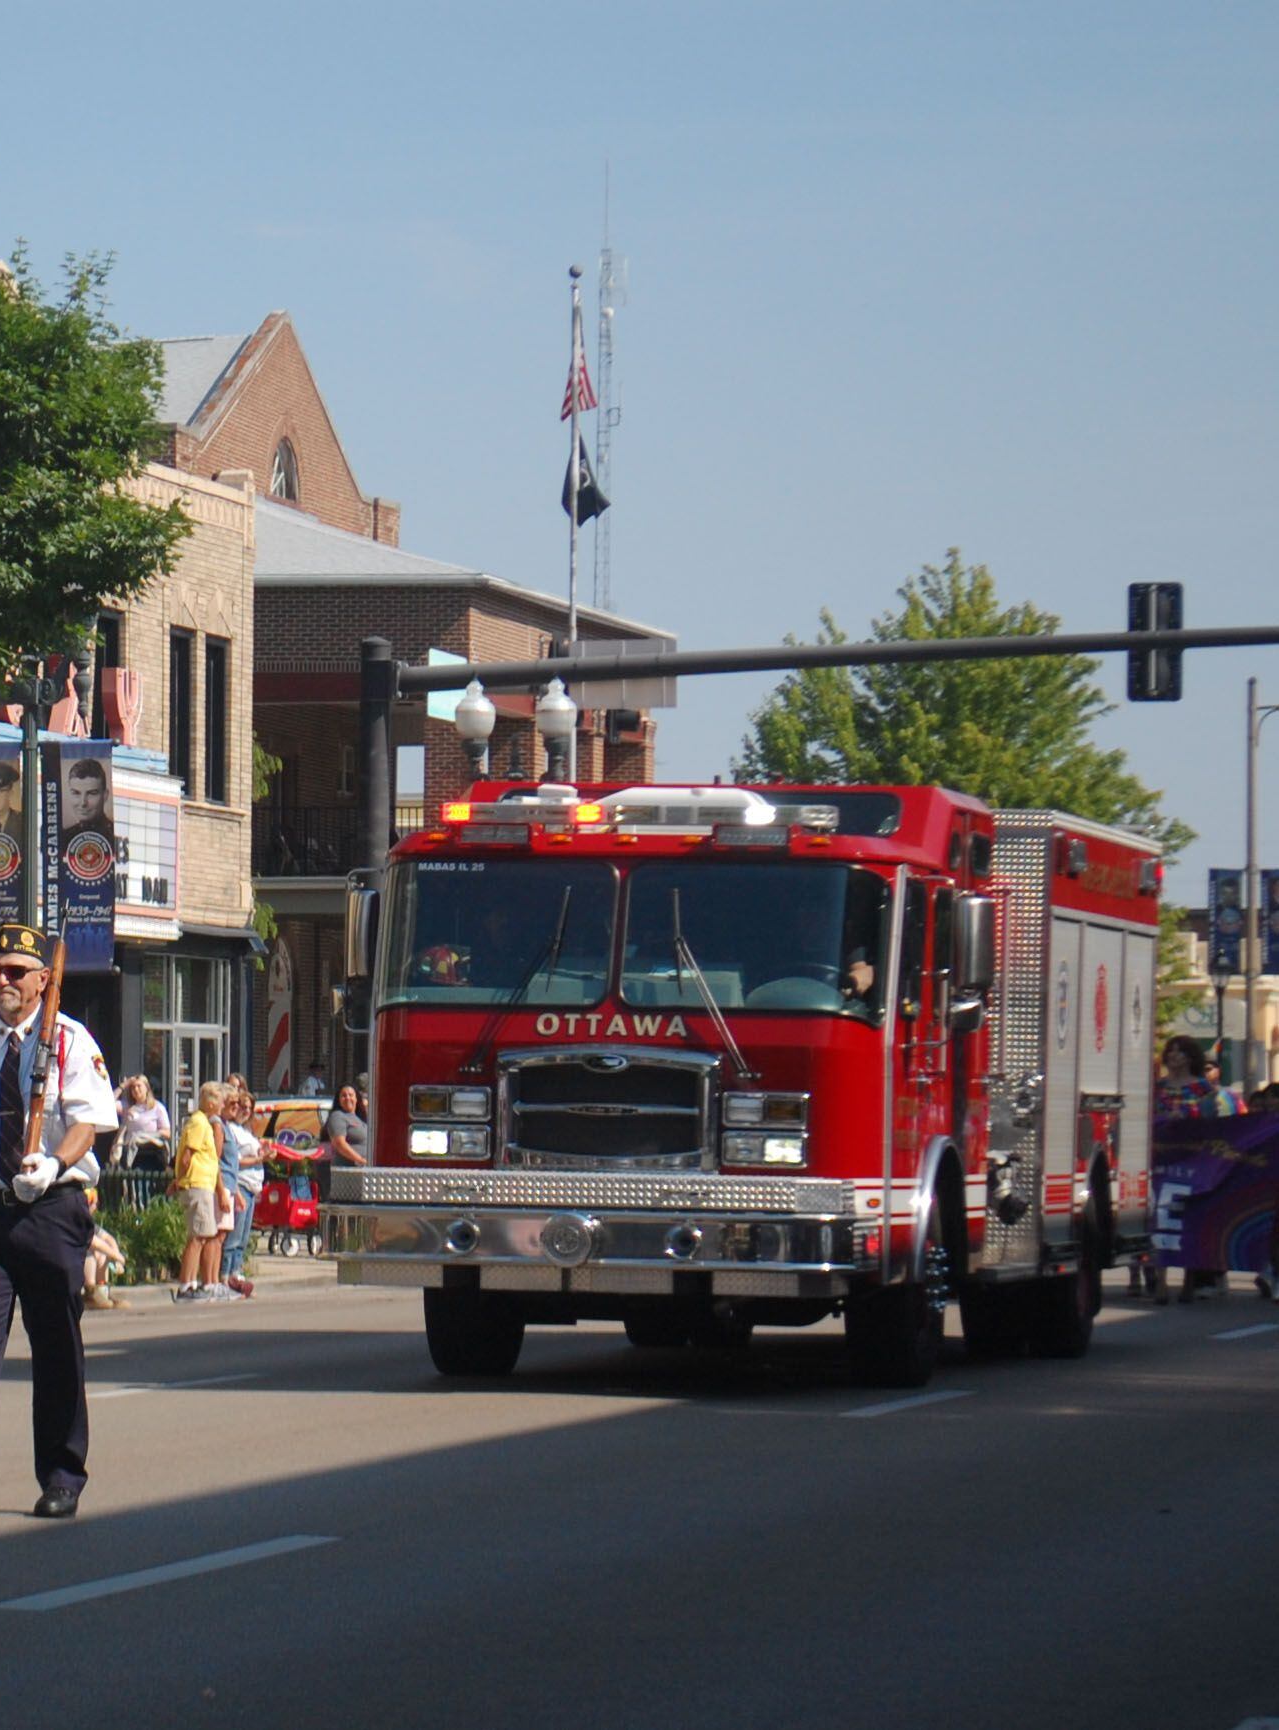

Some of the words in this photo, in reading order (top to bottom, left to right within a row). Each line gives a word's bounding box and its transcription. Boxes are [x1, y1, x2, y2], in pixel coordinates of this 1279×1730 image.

[46, 781, 58, 879] McCARRENS
[47, 884, 59, 937] JAMES
[536, 1012, 688, 1037] OTTAWA
